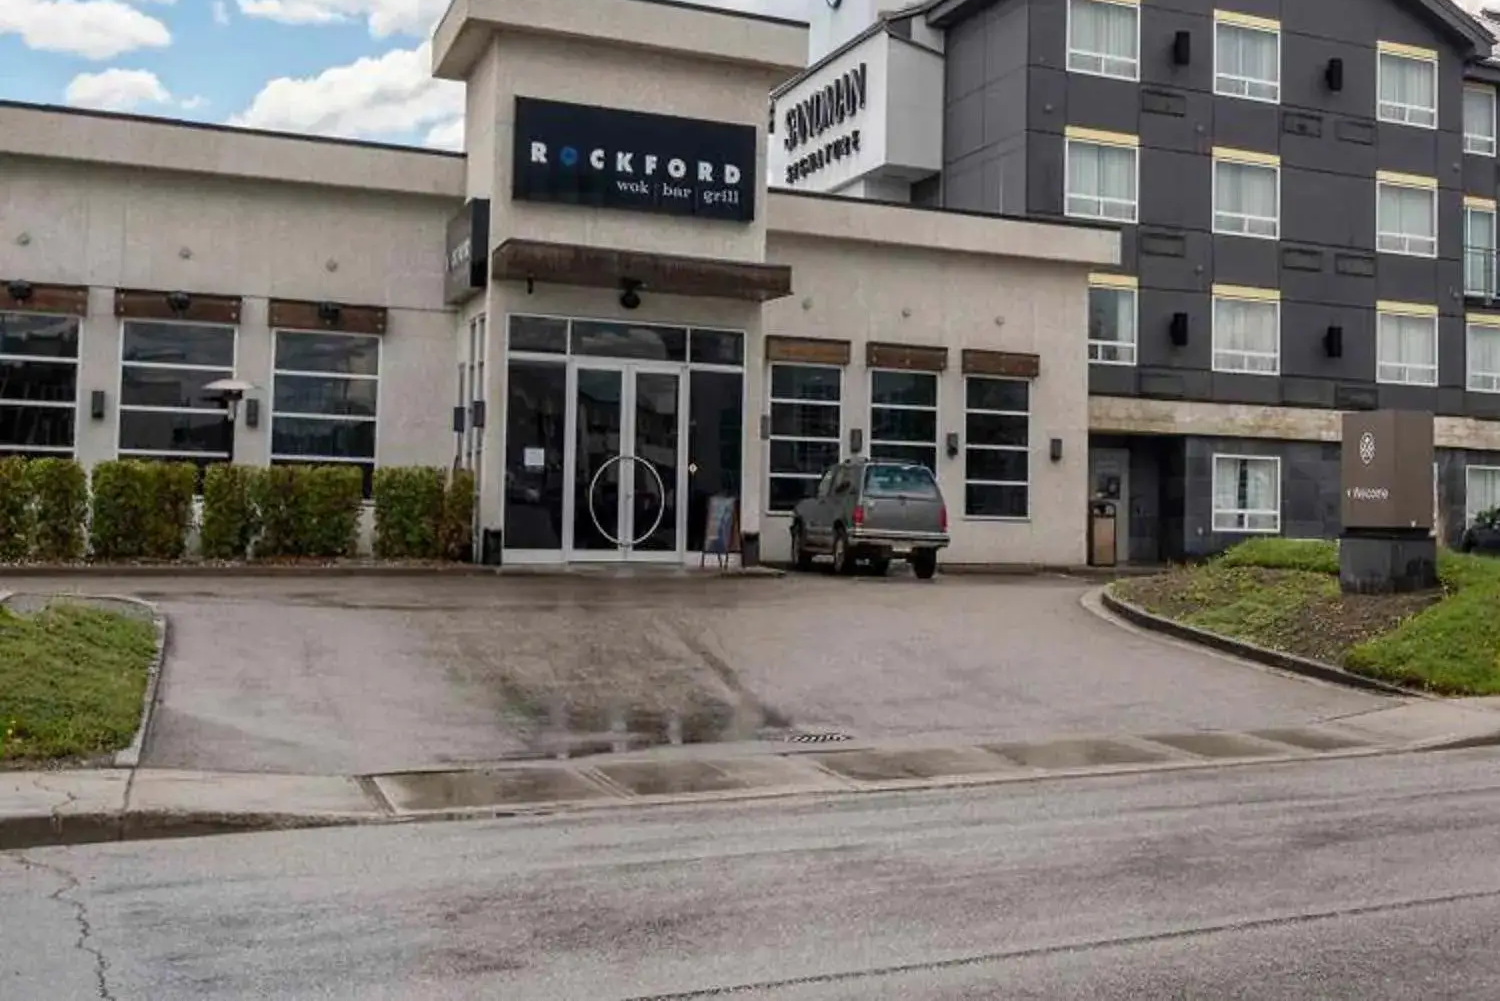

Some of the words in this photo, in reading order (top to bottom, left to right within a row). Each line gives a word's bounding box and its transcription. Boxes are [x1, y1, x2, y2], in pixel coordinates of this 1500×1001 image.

[784, 62, 867, 151] SANDMAN
[530, 141, 742, 184] ROCKFORD
[617, 180, 649, 195] wok
[662, 182, 692, 199] bar
[703, 189, 739, 205] grill
